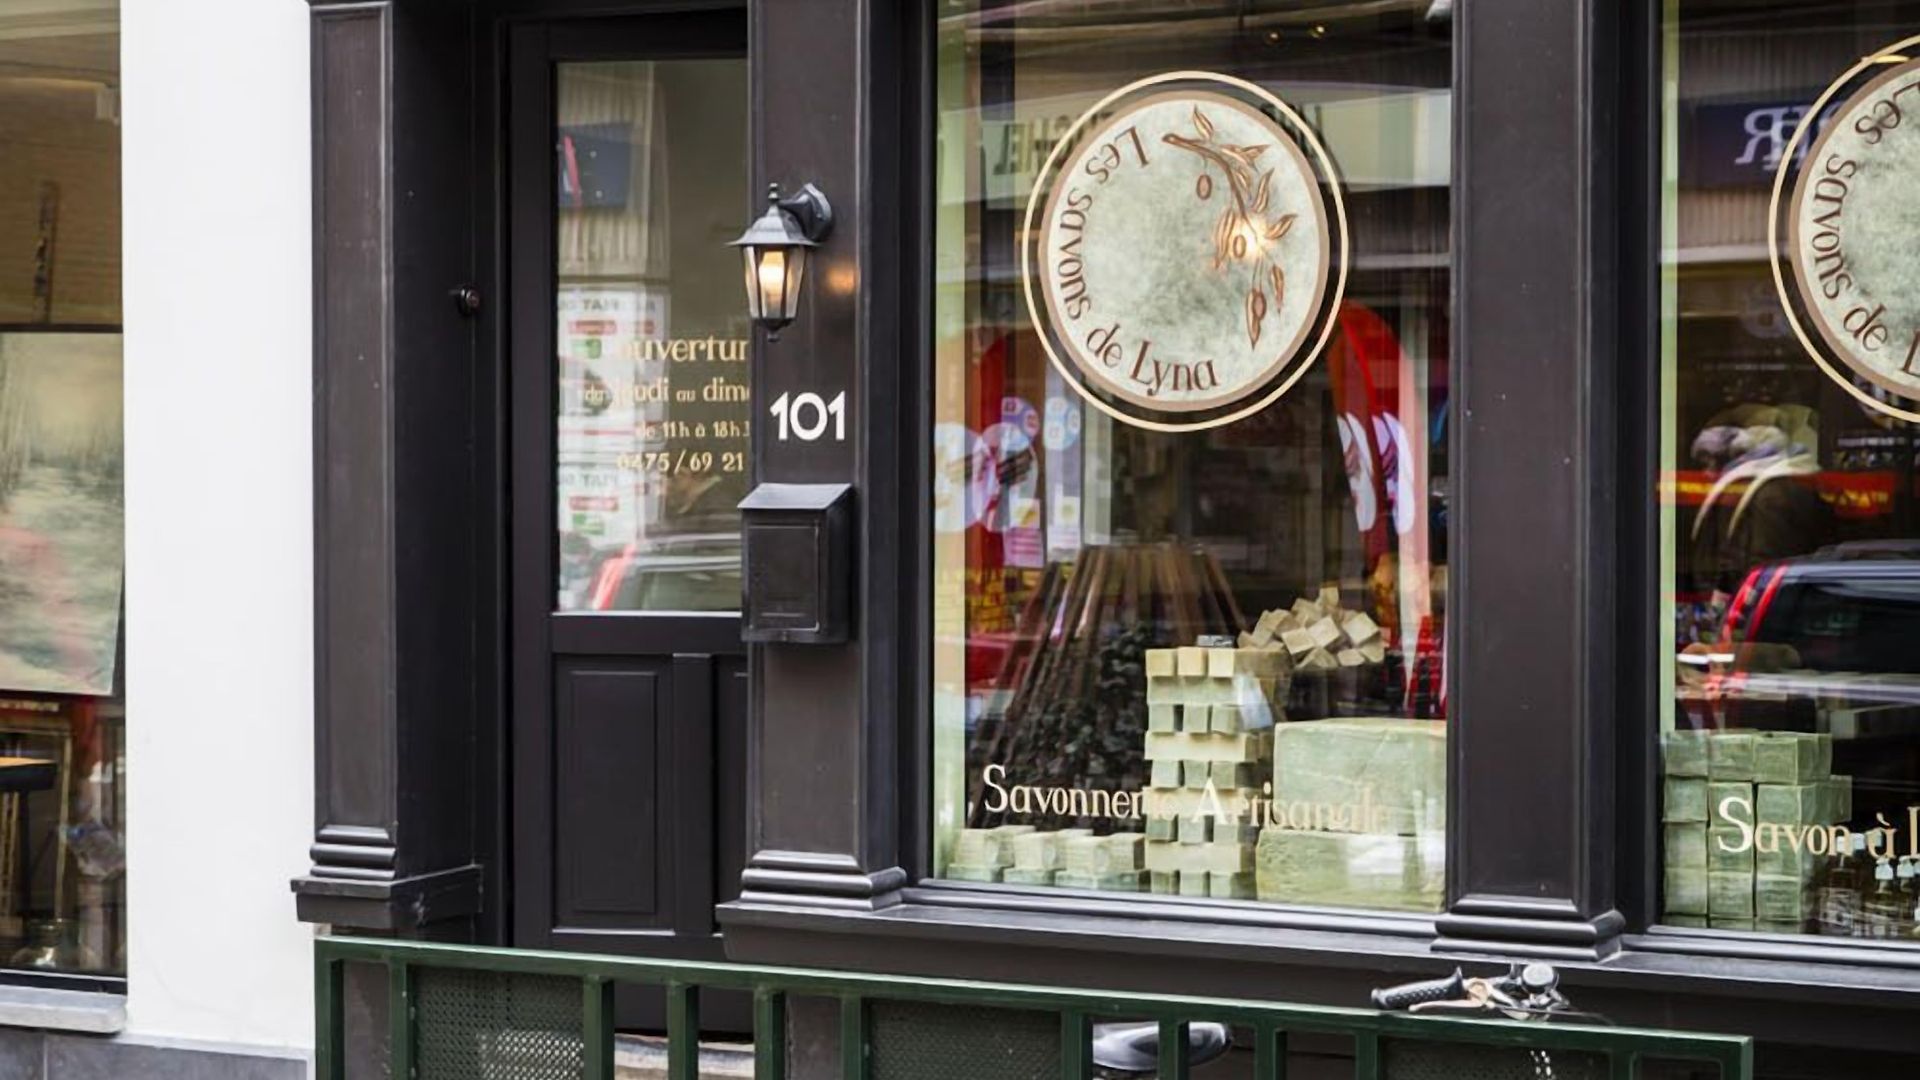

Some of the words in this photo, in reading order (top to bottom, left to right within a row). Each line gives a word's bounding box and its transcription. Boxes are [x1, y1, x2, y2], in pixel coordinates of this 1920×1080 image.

[1085, 126, 1149, 184] Les
[1058, 187, 1092, 321] savons
[1812, 153, 1857, 301] savons
[1843, 304, 1888, 353] de
[618, 334, 749, 362] uvertur
[1086, 323, 1123, 368] de
[1129, 340, 1220, 397] Lyna
[676, 388, 696, 402] au
[703, 376, 750, 402] dim
[769, 390, 846, 441] 101
[722, 451, 744, 471] 21
[1717, 796, 1850, 857] Savon
[1866, 812, 1898, 859] à
